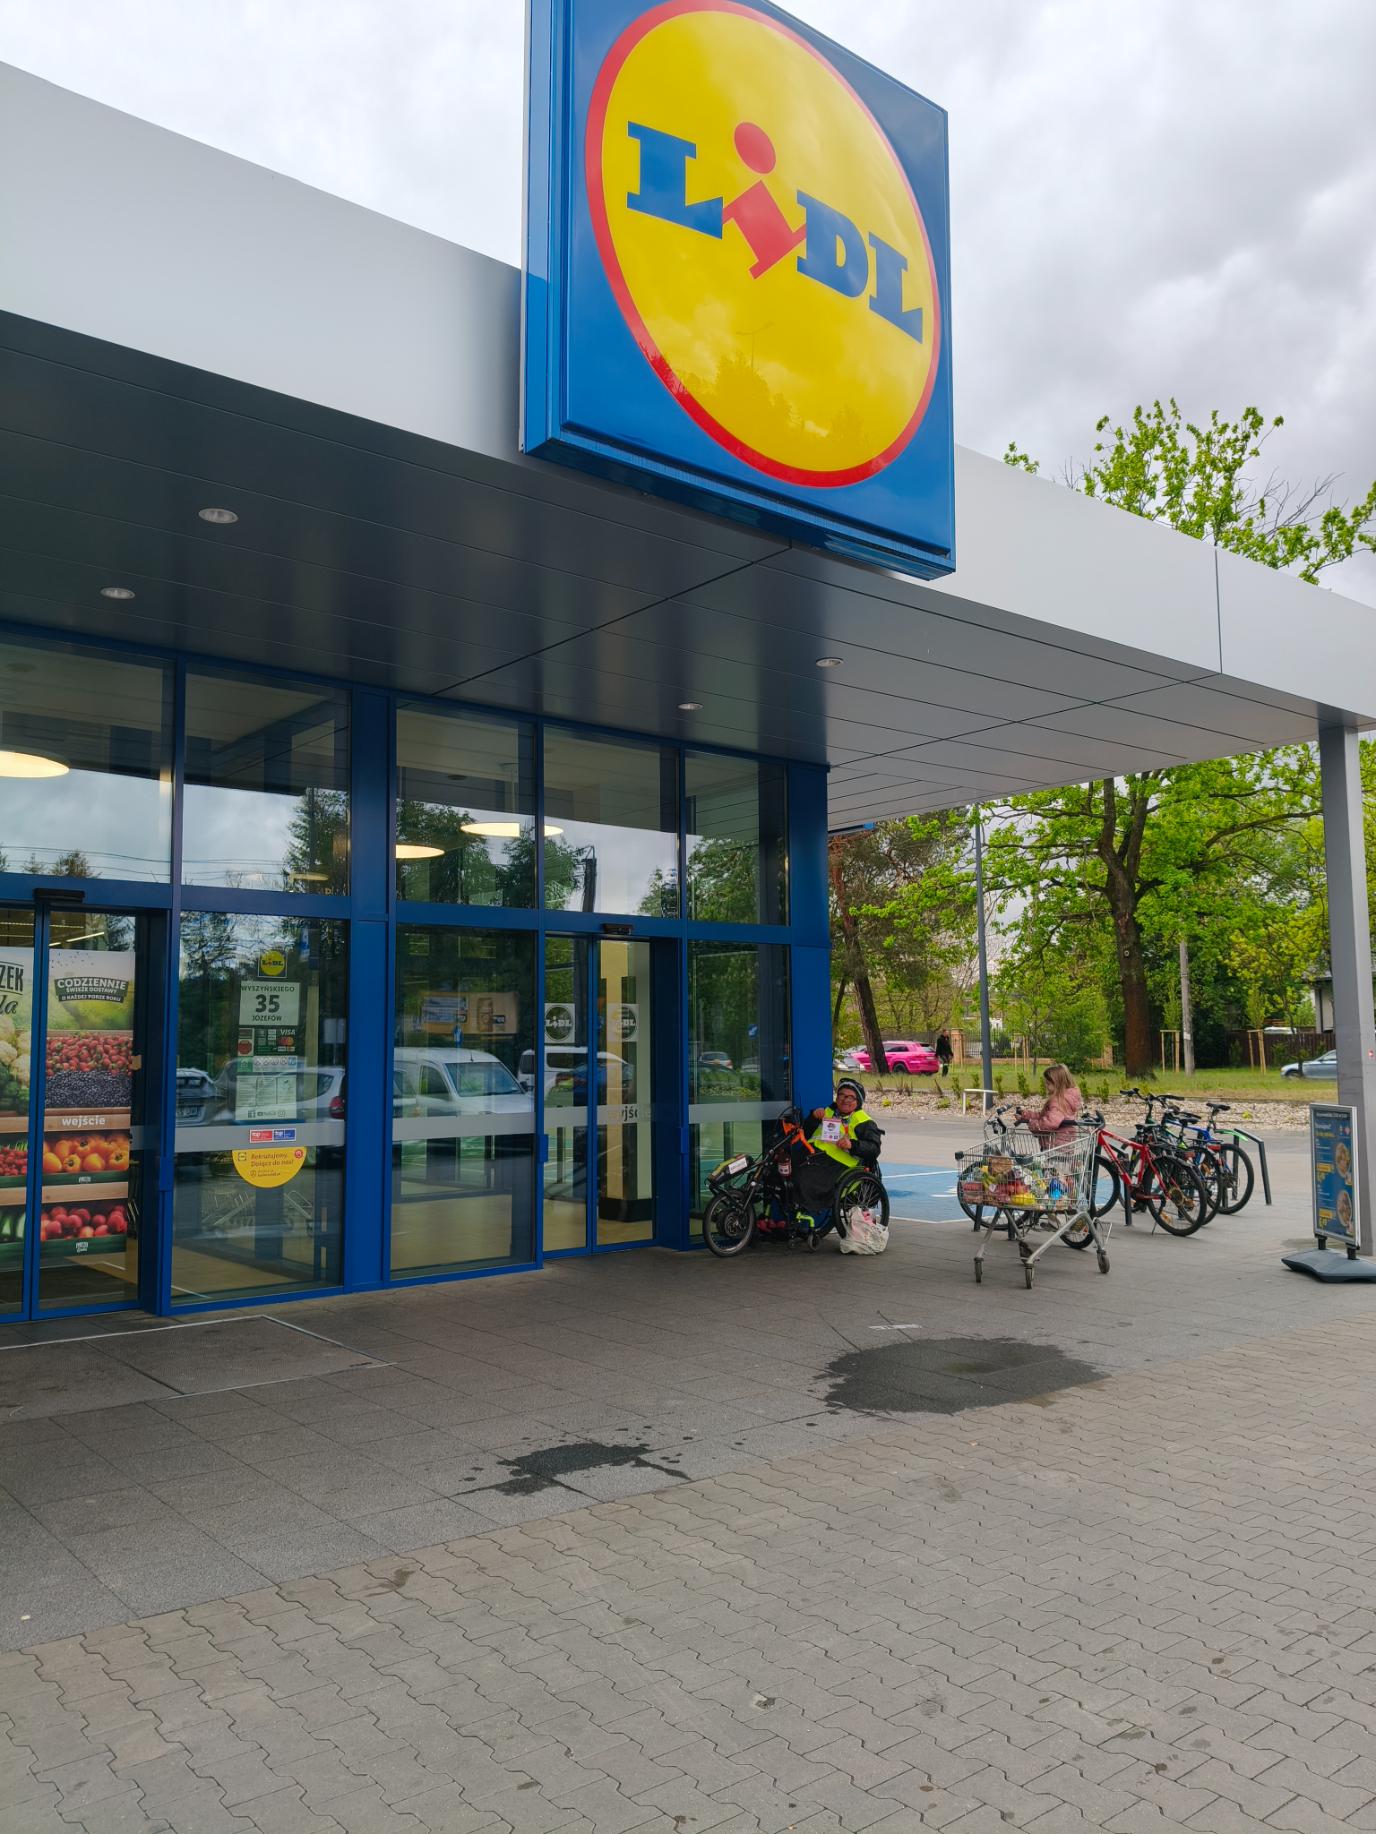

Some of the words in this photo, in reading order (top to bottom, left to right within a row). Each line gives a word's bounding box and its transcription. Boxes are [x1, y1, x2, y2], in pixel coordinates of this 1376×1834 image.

[57, 977, 127, 990] CODZIENNIE
[241, 984, 295, 992] WYSZYŃSKIEGO
[255, 993, 280, 1013] 35
[252, 1014, 283, 1022] JÓZEFÓW
[280, 1028, 296, 1036] VISA
[61, 1115, 106, 1128] wejście
